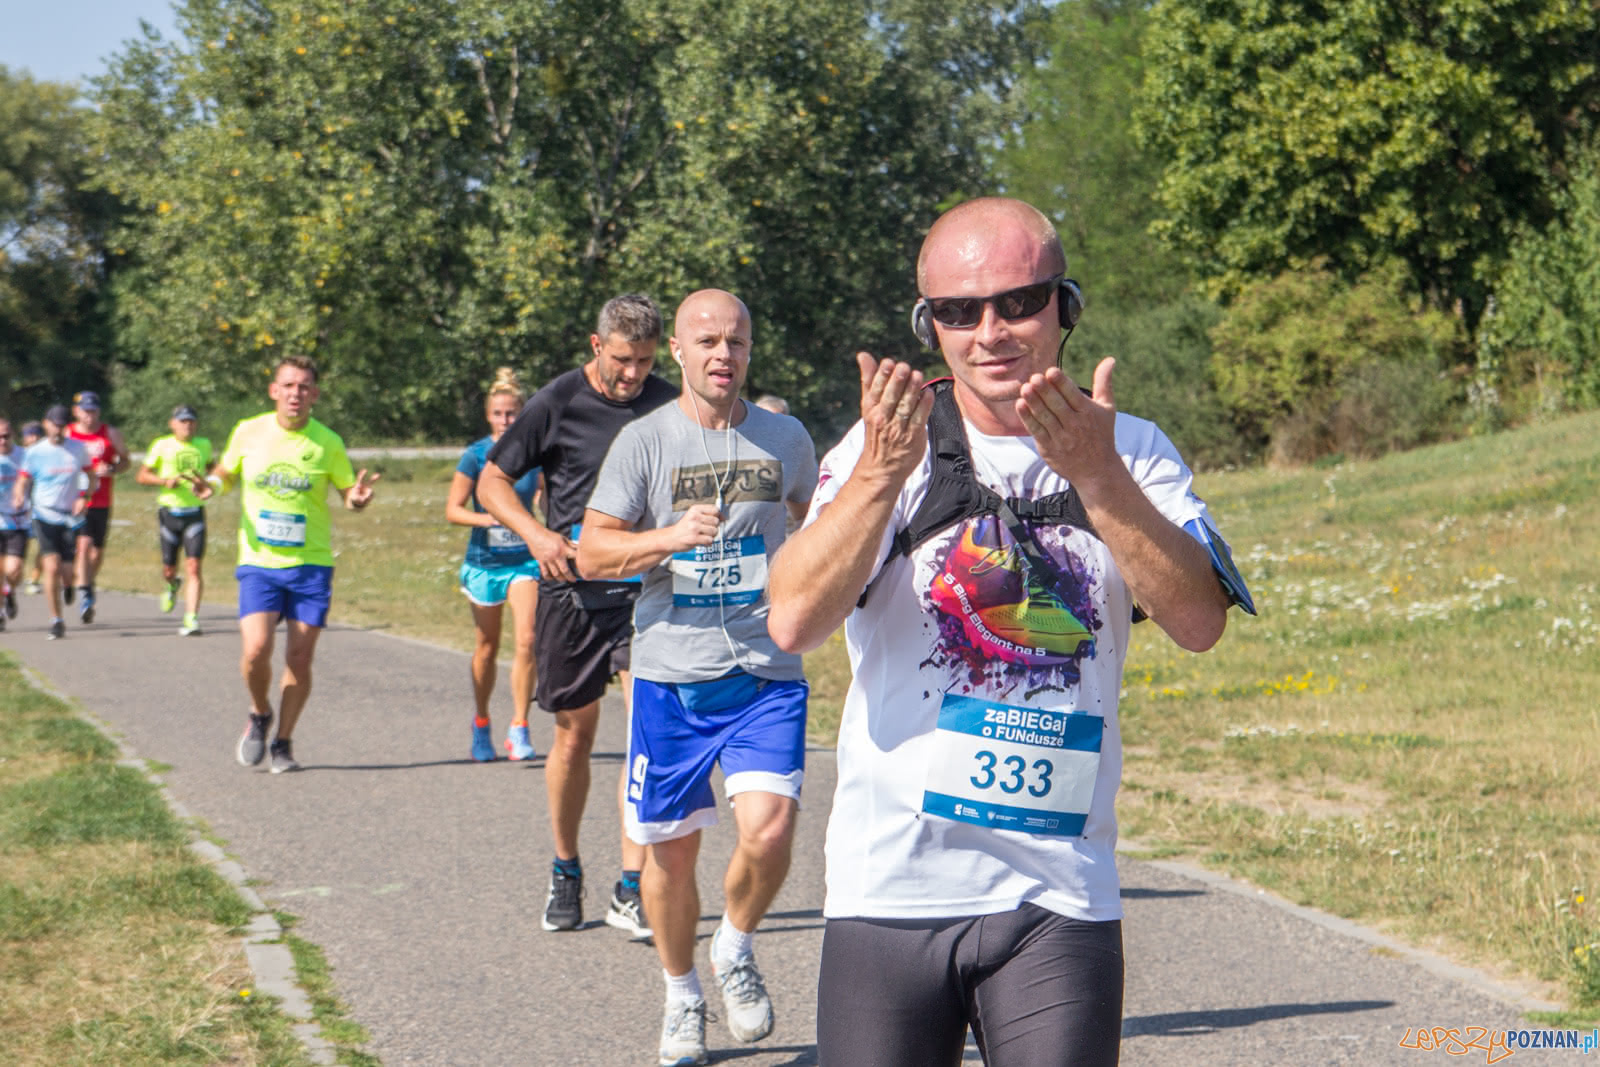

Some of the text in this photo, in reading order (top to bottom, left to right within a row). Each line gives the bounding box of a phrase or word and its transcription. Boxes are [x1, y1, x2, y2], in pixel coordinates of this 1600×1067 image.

[267, 524, 293, 537] 237
[695, 564, 742, 589] 725
[952, 583, 973, 615] Bieg
[969, 612, 1013, 651] Elegant
[1015, 645, 1033, 655] na
[1035, 647, 1046, 656] 5
[983, 707, 1068, 736] zaBIEGaj
[982, 726, 1064, 748] o FUNdusze
[970, 750, 1054, 798] 333
